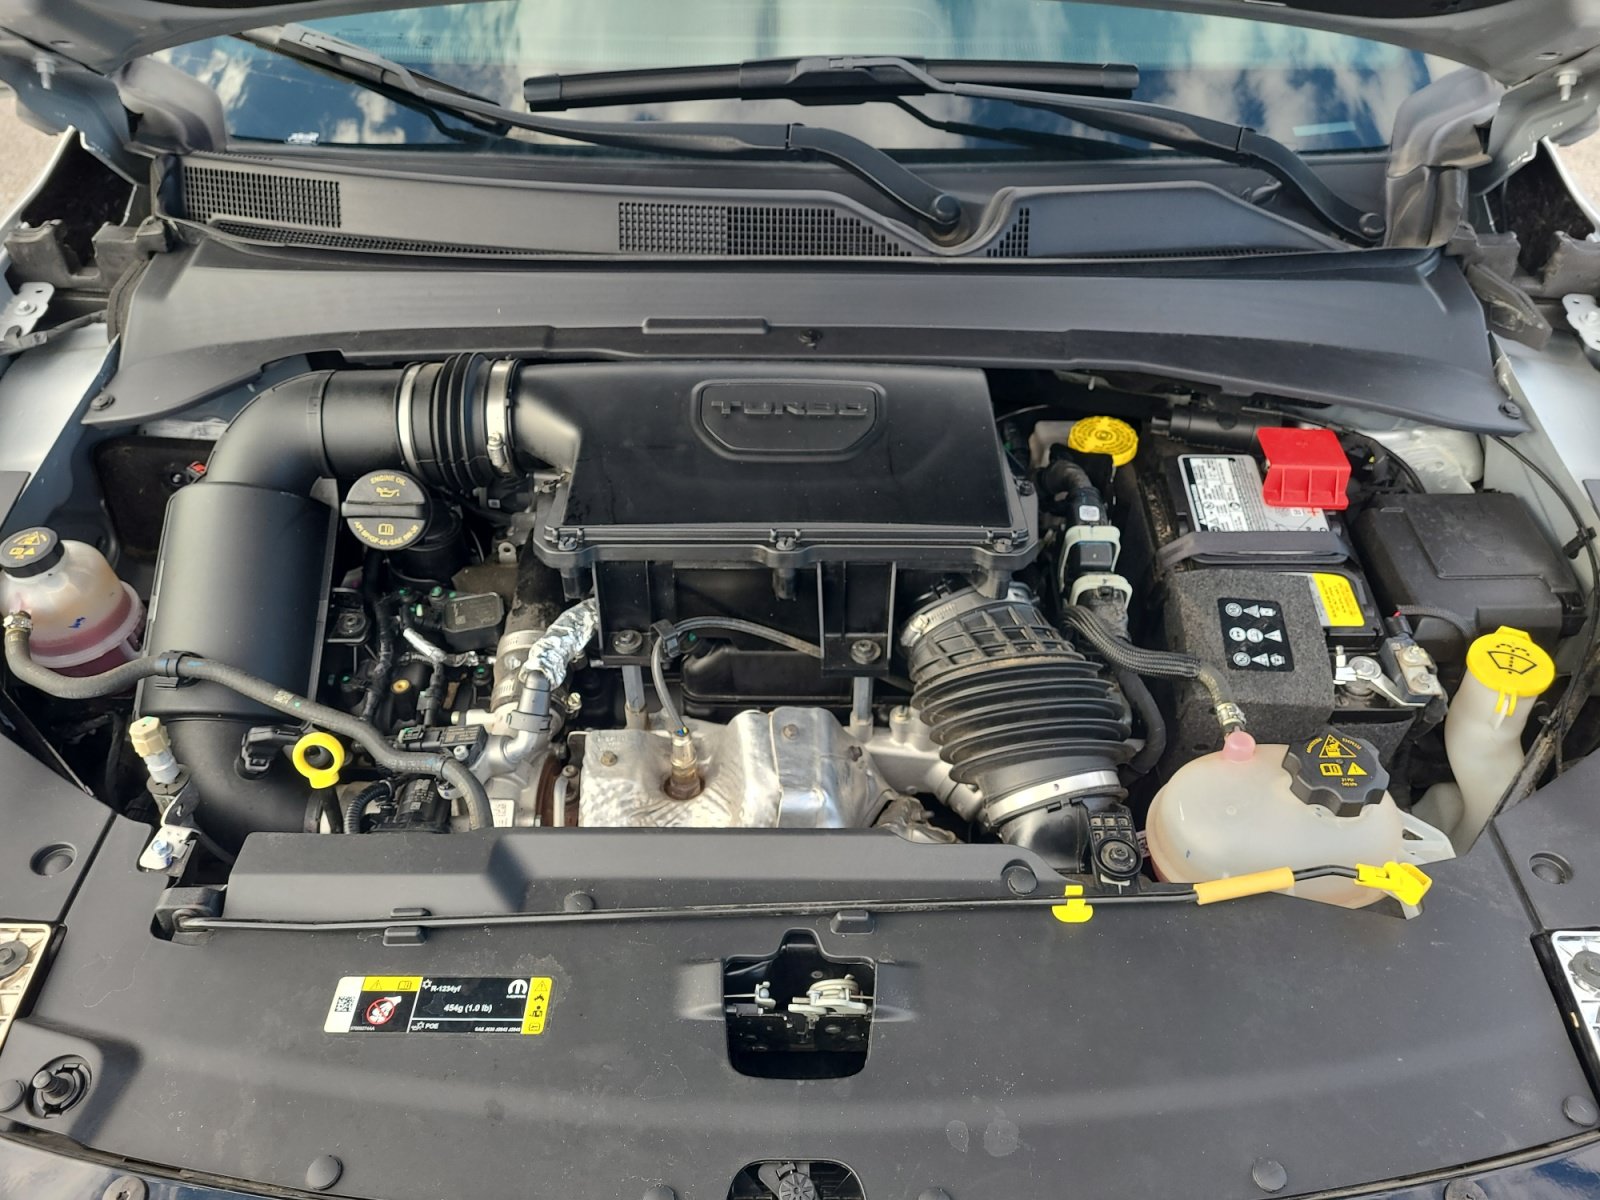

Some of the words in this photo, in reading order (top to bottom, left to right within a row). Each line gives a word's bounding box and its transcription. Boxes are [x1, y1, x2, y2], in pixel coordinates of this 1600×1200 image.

[711, 400, 868, 416] TURBO
[370, 474, 395, 485] ENGINE
[395, 477, 406, 486] OIL
[430, 985, 462, 994] R-1234yf
[443, 1004, 464, 1013] 454g
[465, 1004, 480, 1014] (1.0
[481, 1004, 493, 1014] lb)
[425, 1022, 439, 1030] POE
